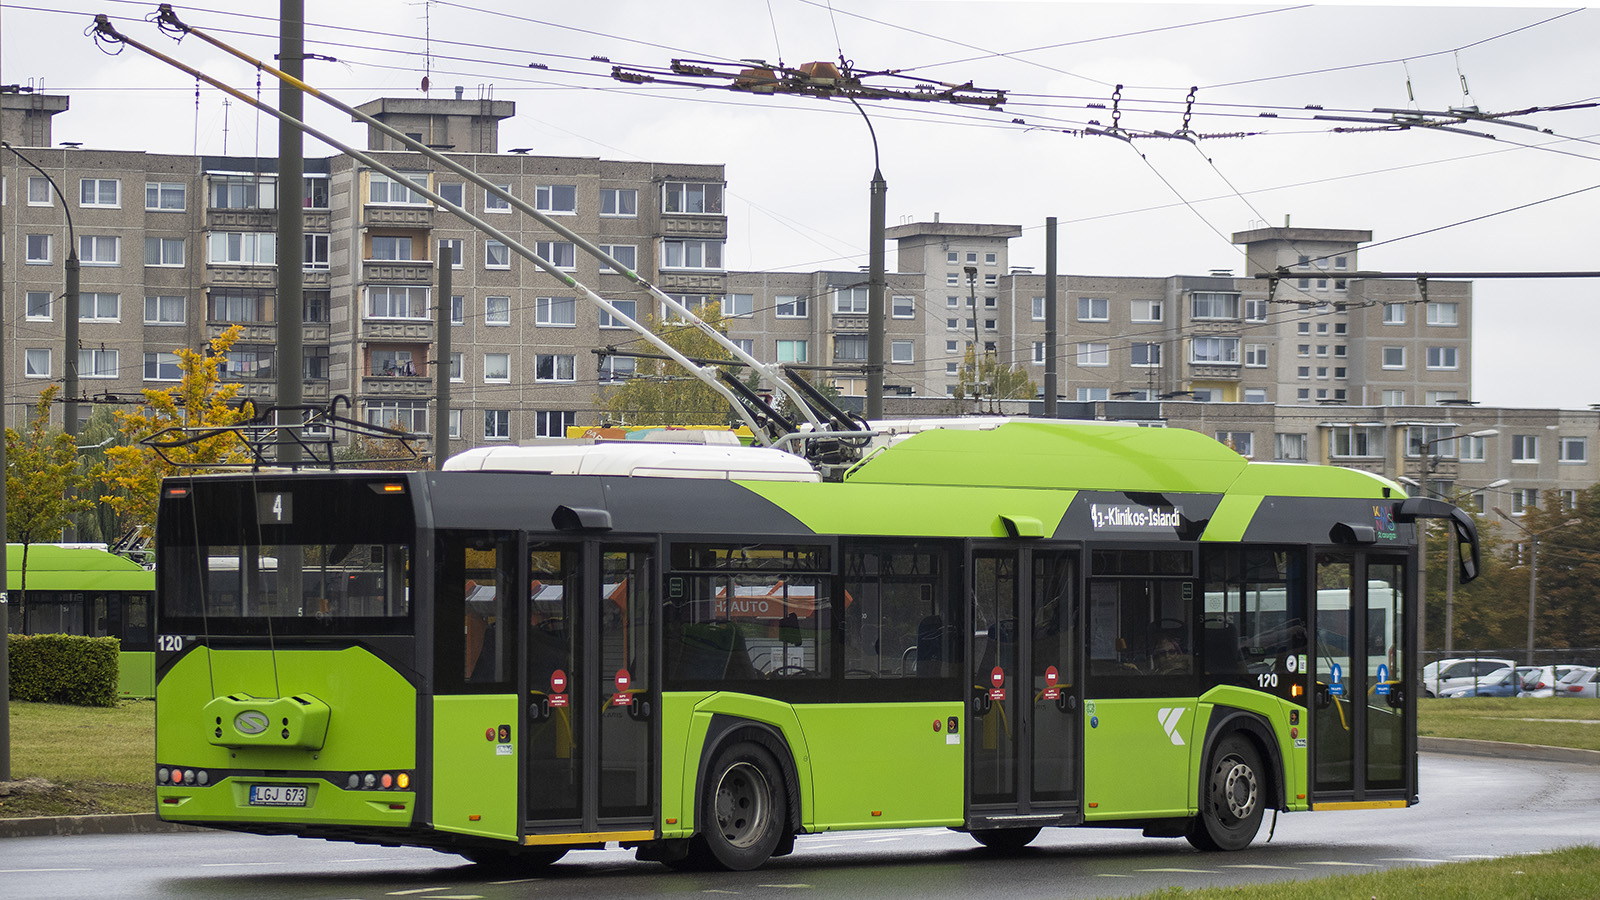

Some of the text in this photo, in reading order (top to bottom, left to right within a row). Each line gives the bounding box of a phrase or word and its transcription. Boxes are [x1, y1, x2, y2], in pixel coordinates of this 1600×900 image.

[273, 494, 282, 521] 4
[158, 635, 183, 652] 120
[1257, 673, 1279, 688] 120
[256, 788, 305, 801] LGJ 673
